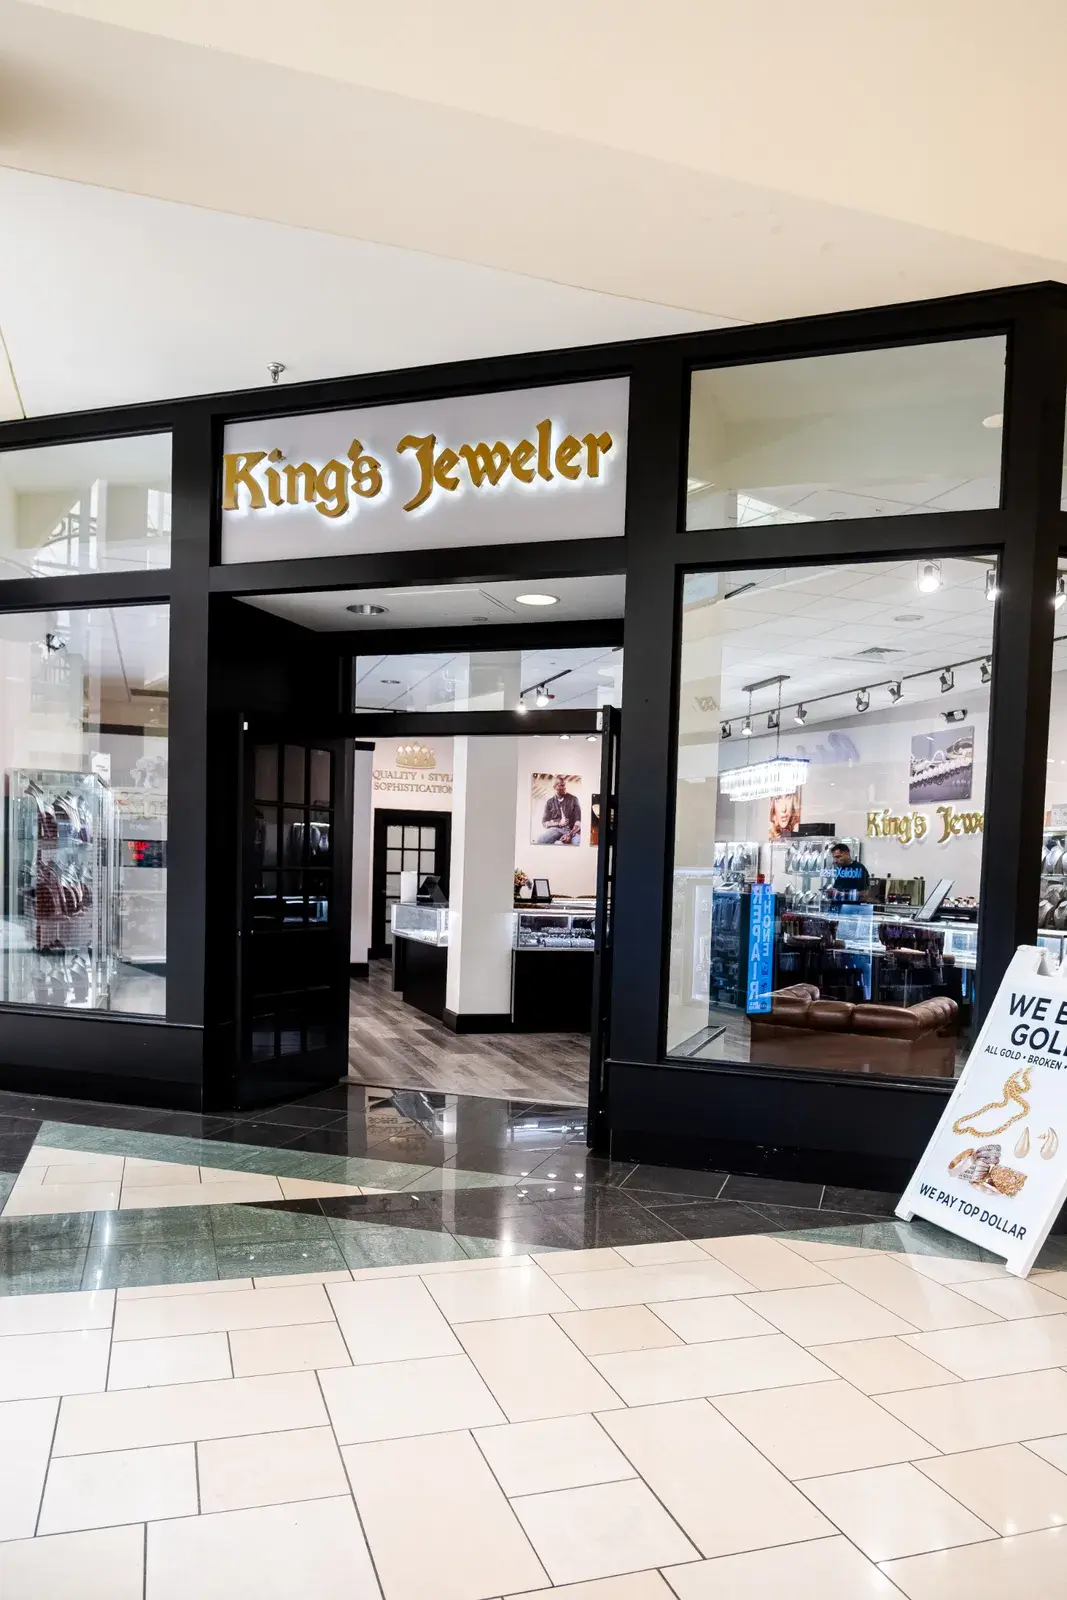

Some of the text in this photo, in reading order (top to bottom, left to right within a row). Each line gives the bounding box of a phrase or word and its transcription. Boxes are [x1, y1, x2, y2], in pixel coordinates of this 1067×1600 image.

[222, 418, 613, 519] King's Jeweler
[372, 769, 417, 781] QUALITY
[866, 808, 928, 844] King's
[1009, 992, 1052, 1022] WE
[1010, 1023, 1067, 1057] GOL
[984, 1045, 1063, 1070] ALL GOLD BROKEN
[919, 1182, 1027, 1241] WE PAY TOP DOLLAR
